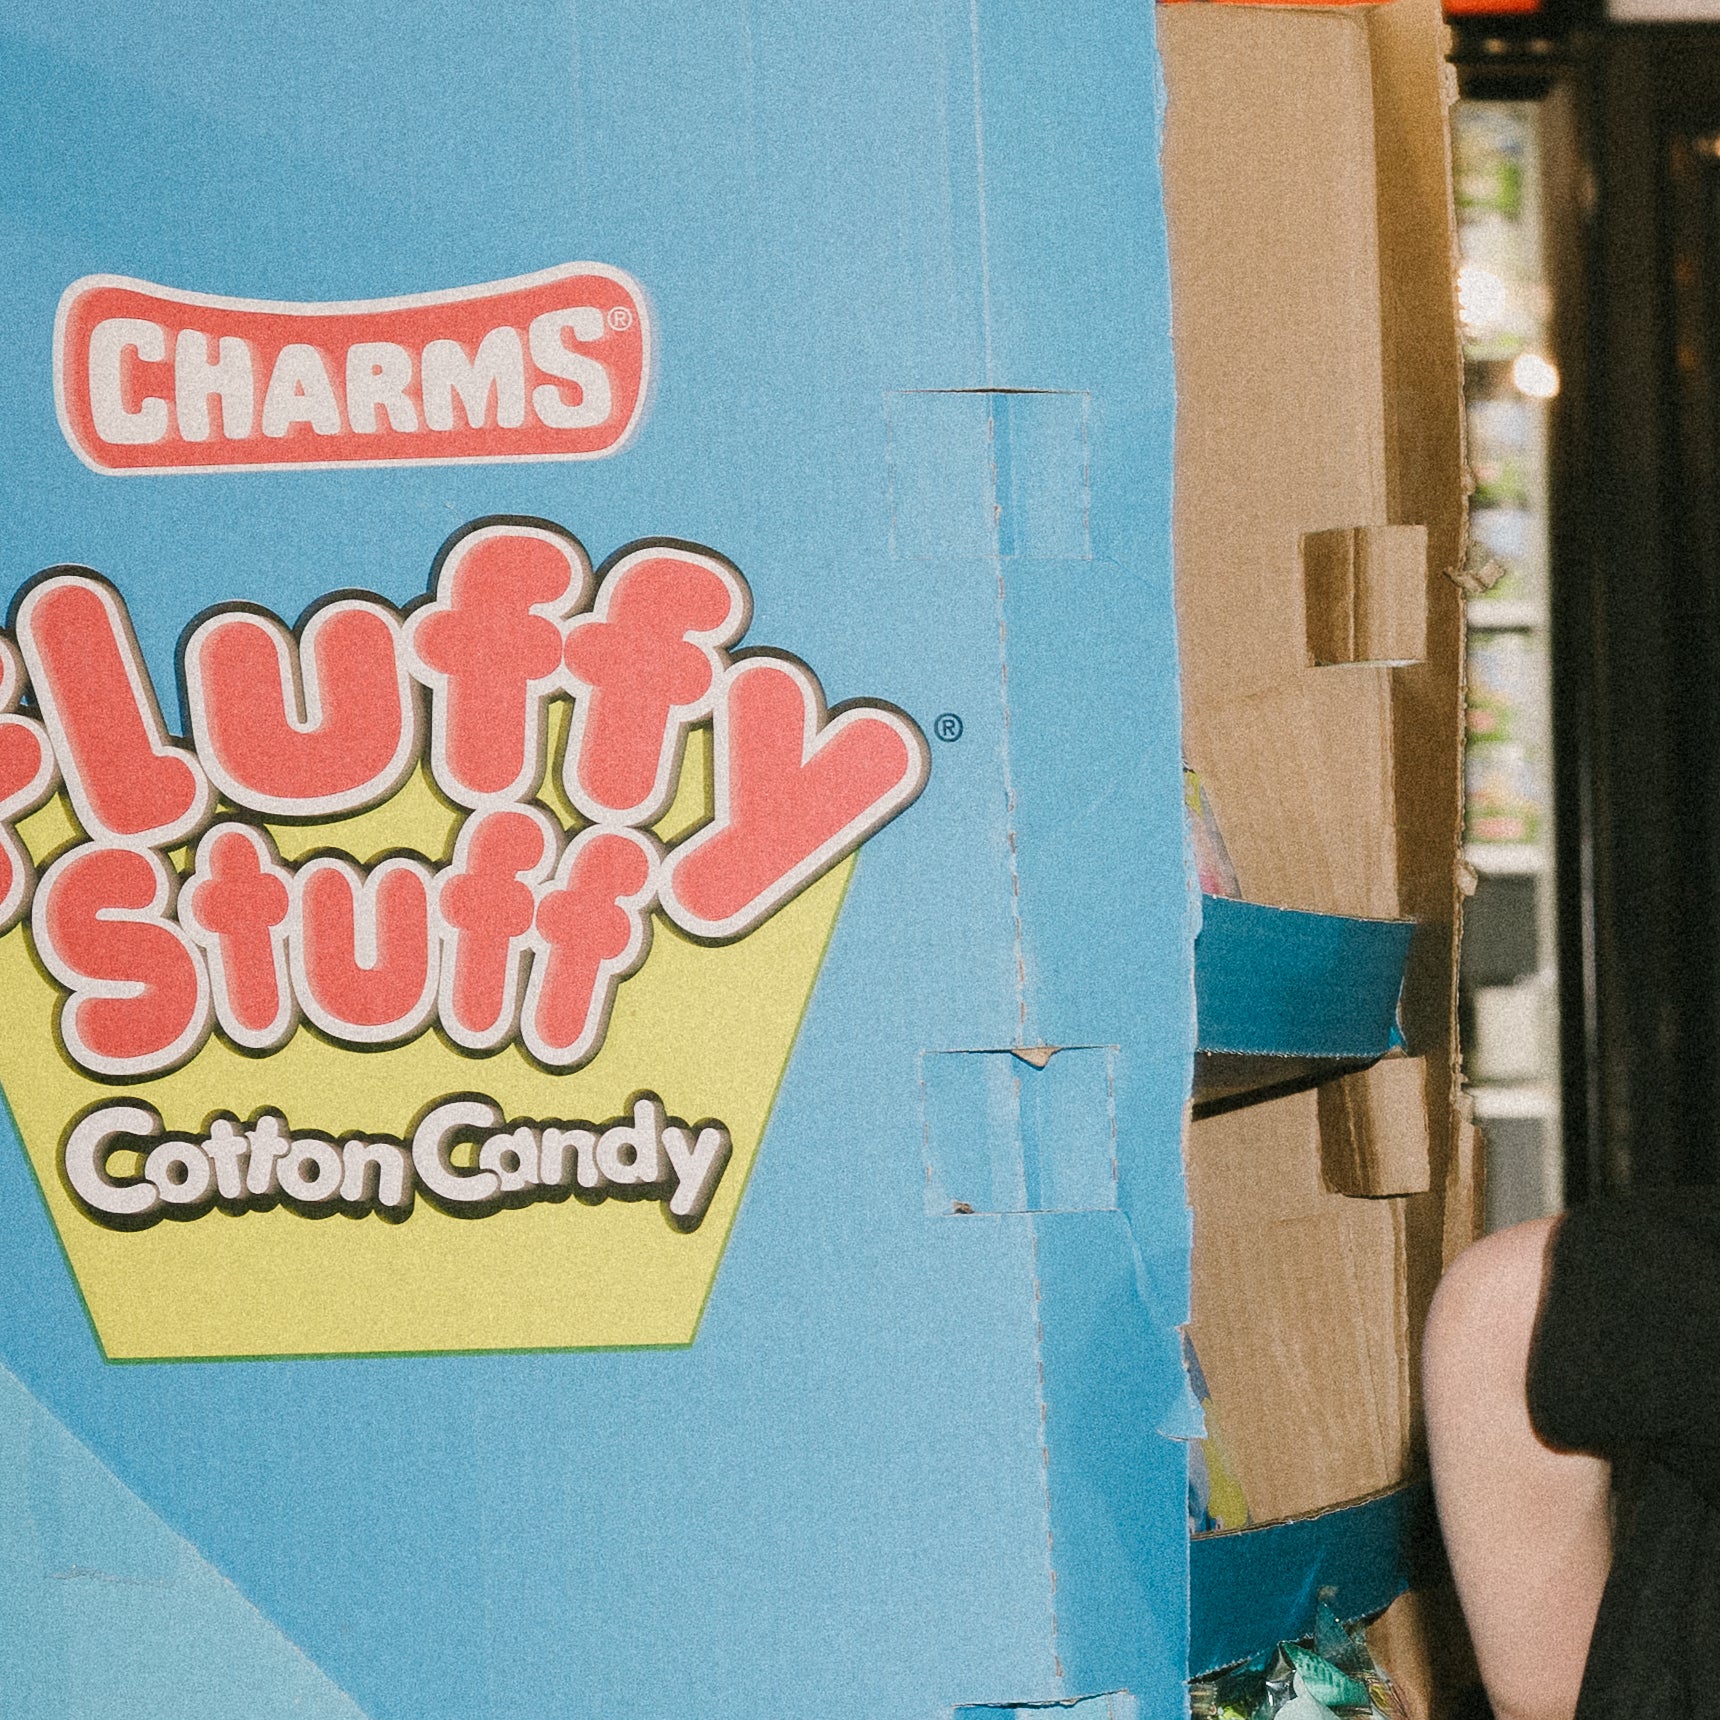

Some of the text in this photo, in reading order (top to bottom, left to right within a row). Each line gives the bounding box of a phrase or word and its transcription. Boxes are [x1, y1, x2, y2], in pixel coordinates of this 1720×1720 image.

[32, 801, 656, 1083] Stuff
[63, 1098, 727, 1218] Cotton Candy
